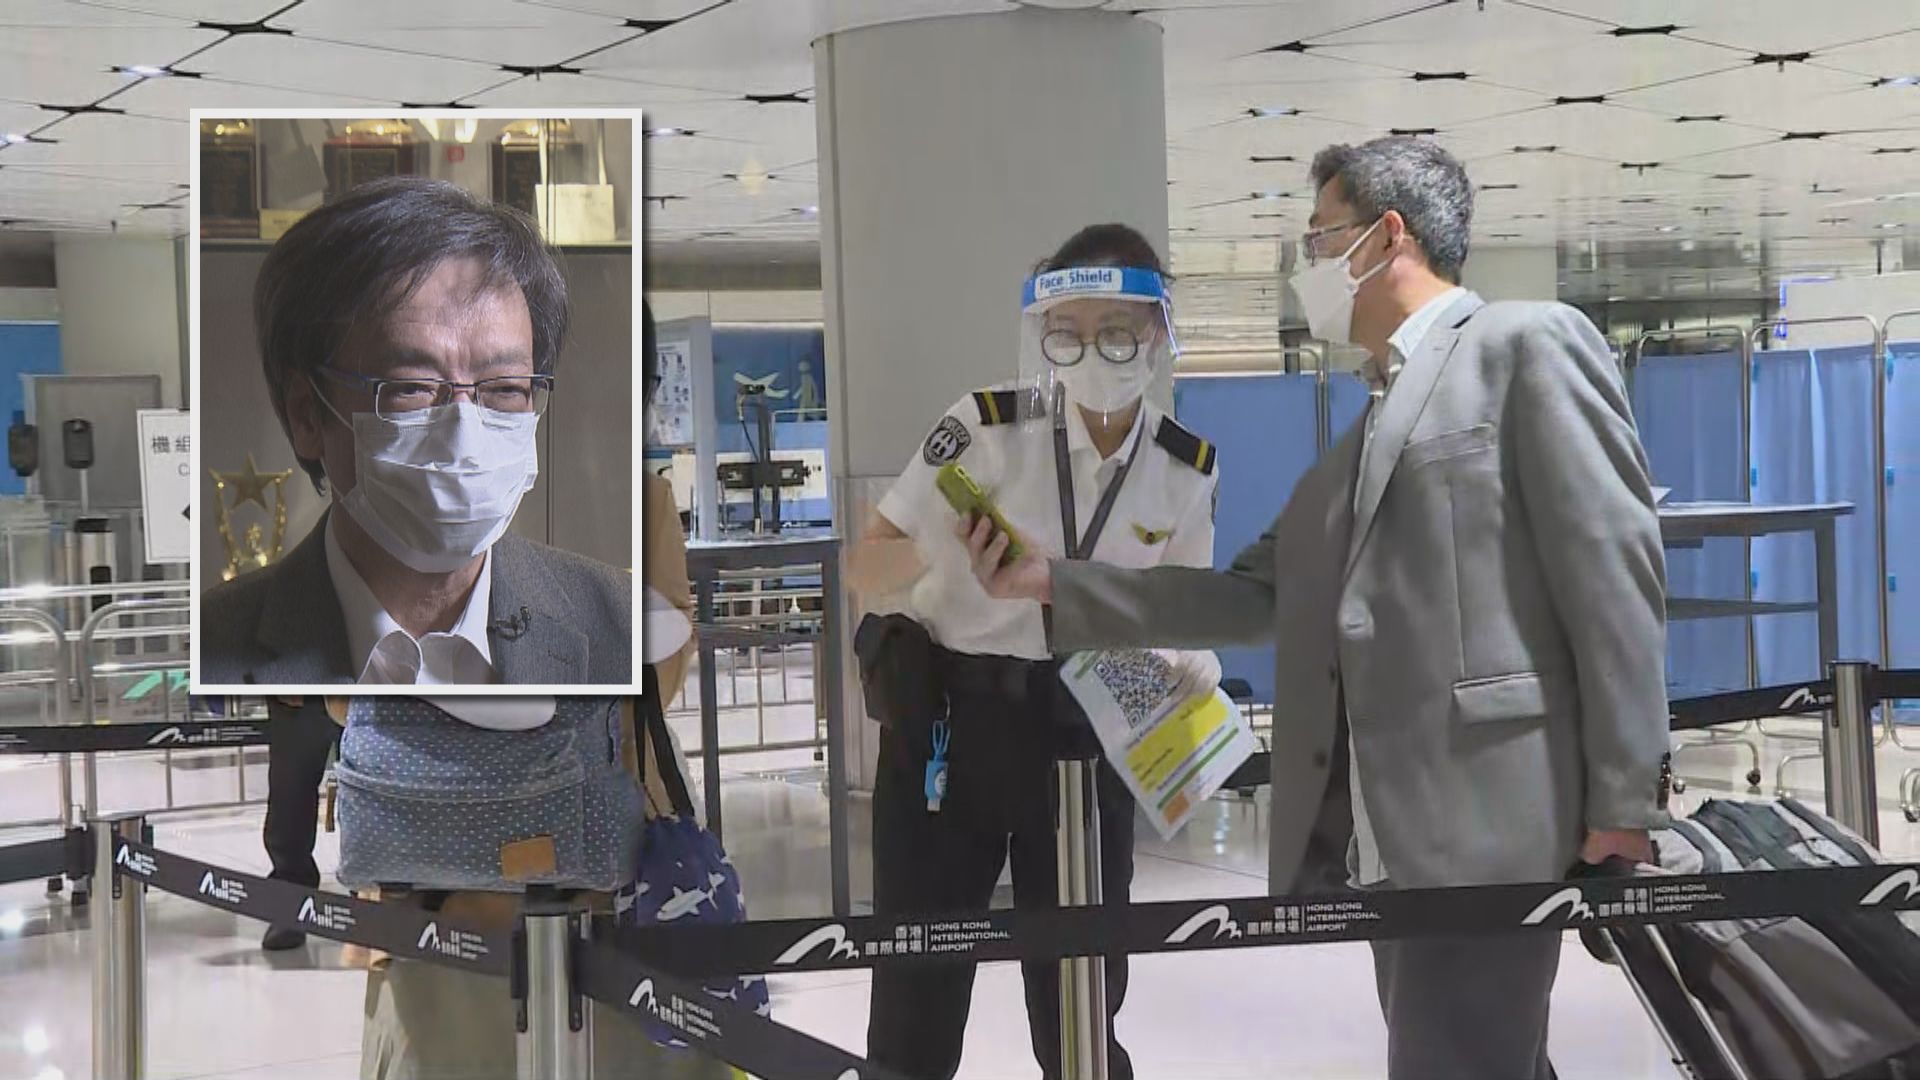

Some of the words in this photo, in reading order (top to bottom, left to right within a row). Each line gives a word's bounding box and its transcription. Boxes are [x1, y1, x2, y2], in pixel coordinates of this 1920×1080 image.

[1040, 275, 1064, 289] Face
[1068, 269, 1112, 284] Shield
[1306, 903, 1333, 912] HONG
[1335, 902, 1362, 911] KONG
[1306, 911, 1382, 922] INTERNATIONAL
[930, 922, 960, 932] HONG
[962, 920, 991, 930] KONG
[1306, 922, 1346, 932] AIRPORT
[930, 932, 1010, 942] INTERNATIONAL
[930, 942, 976, 952] AIRPORT
